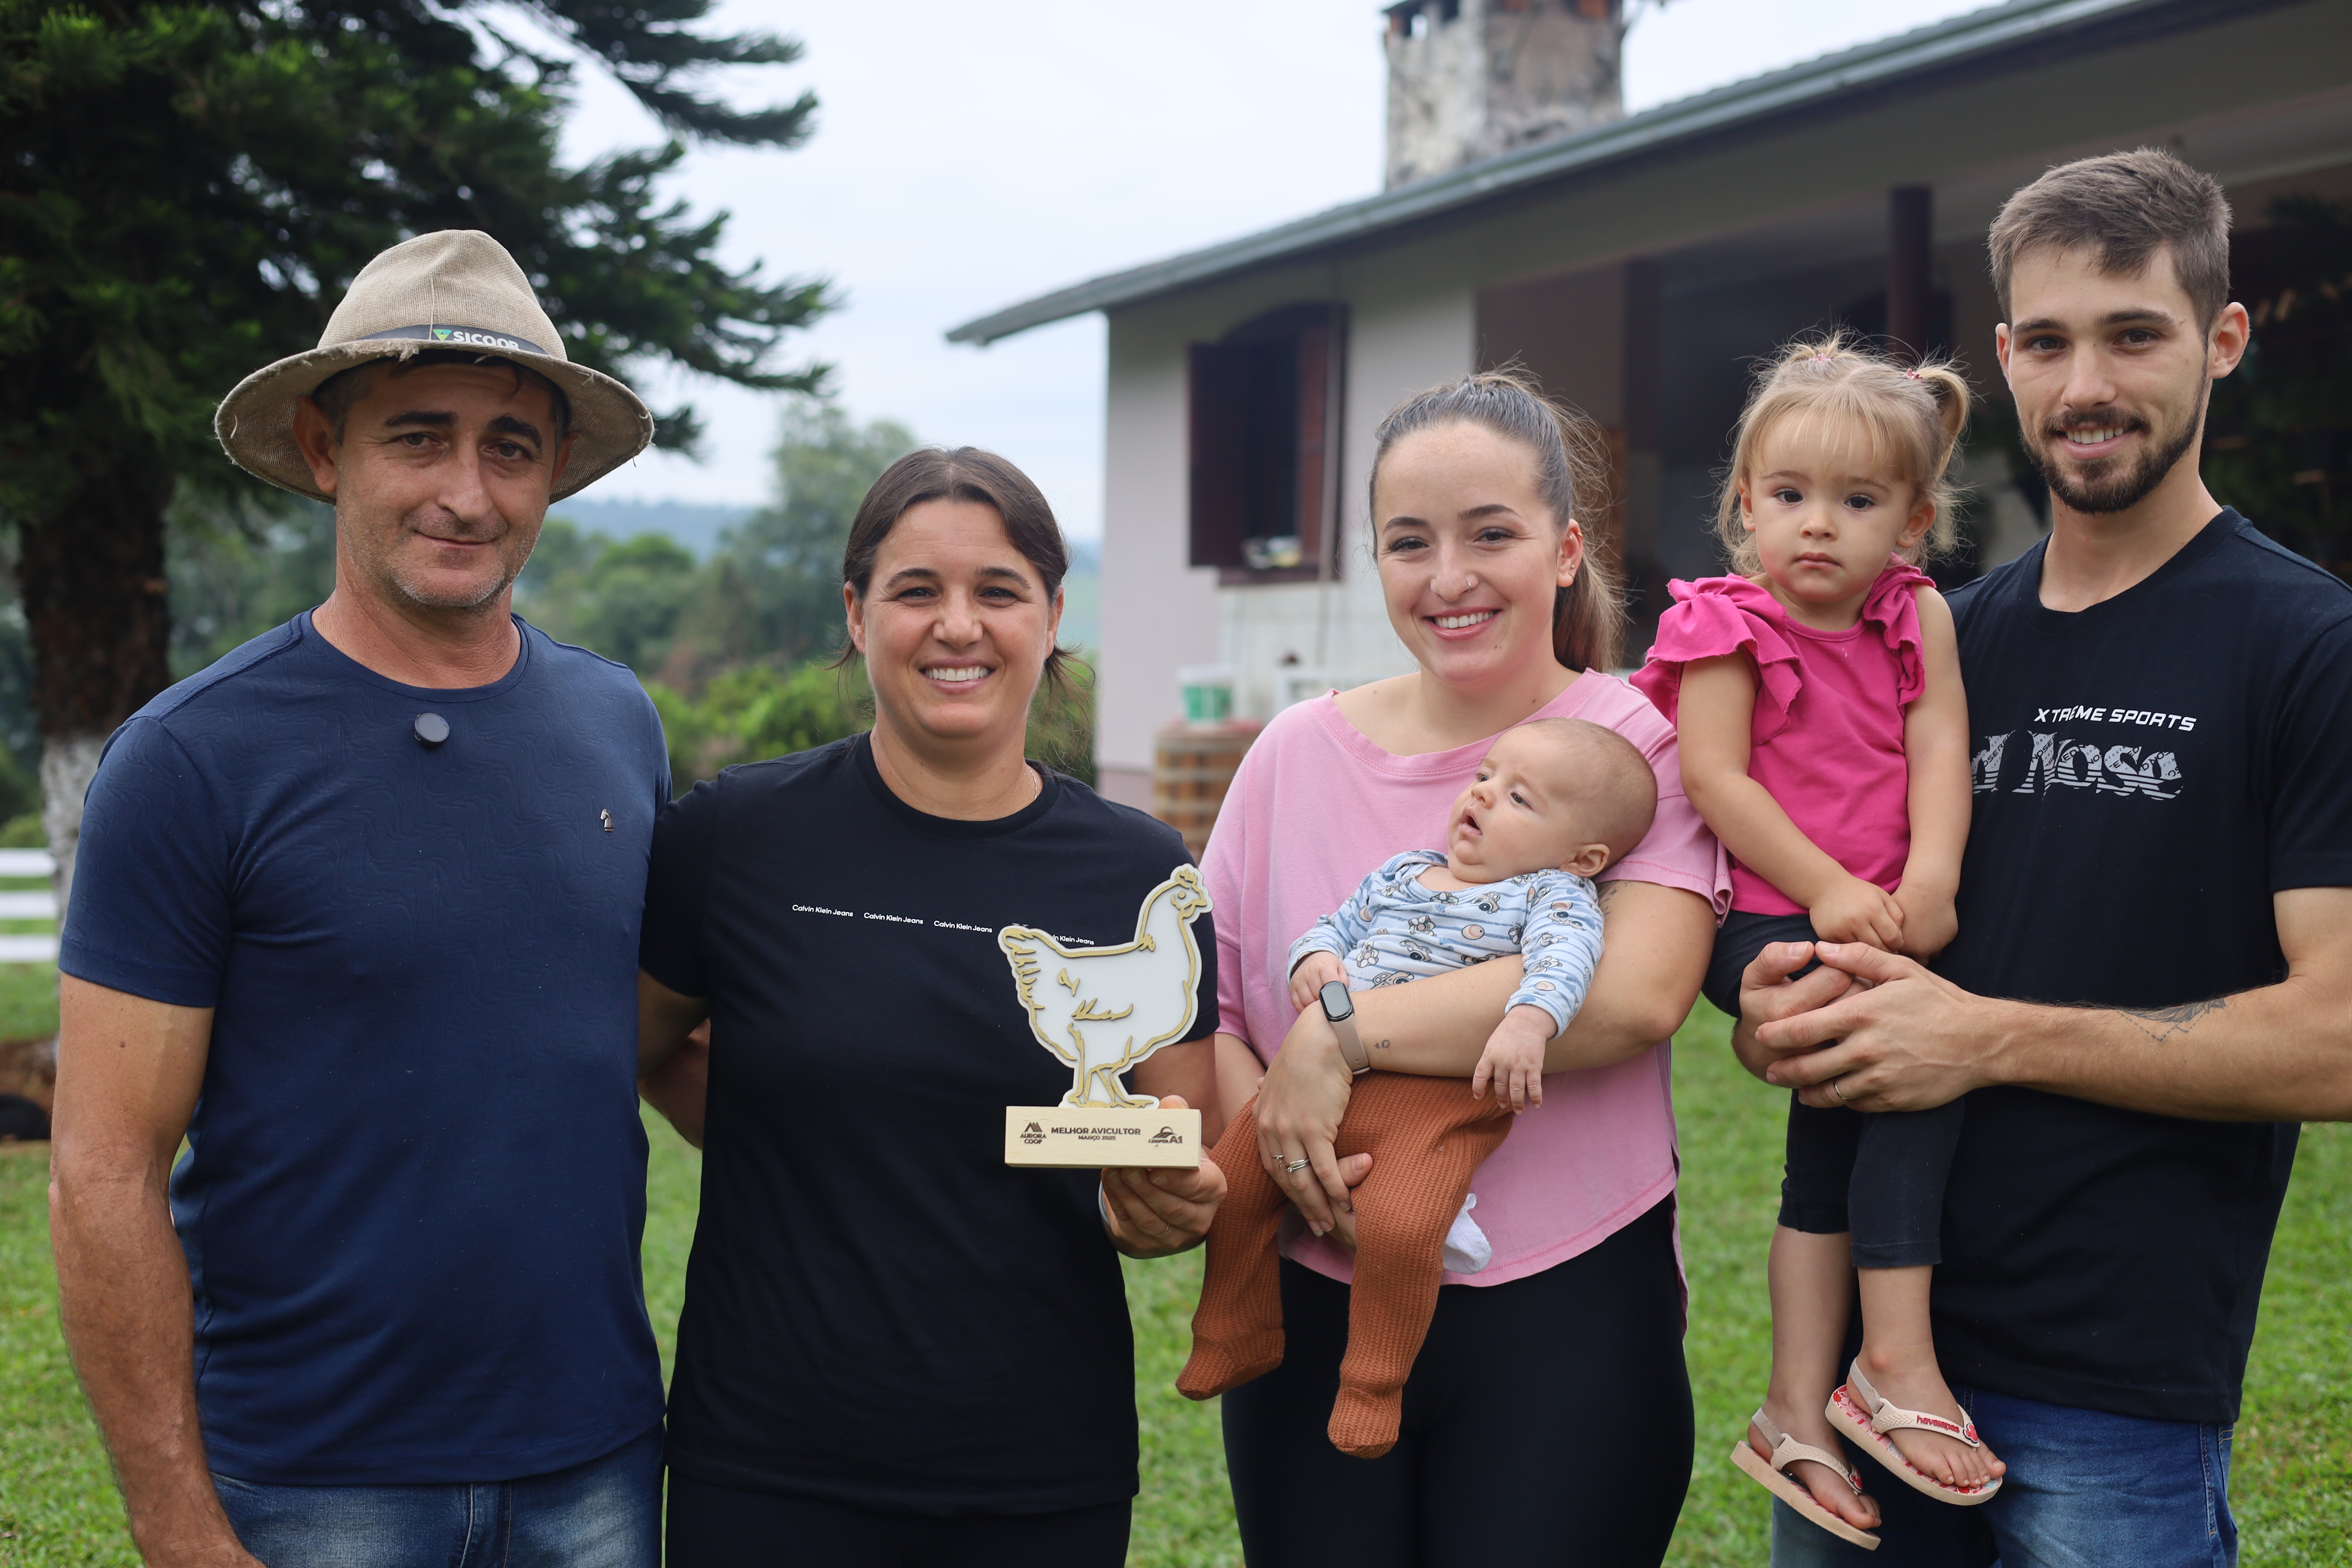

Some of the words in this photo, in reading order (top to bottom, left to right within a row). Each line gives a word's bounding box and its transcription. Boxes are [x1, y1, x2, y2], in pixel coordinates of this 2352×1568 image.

[2034, 705, 2107, 723] XTREME
[2109, 709, 2197, 731] SPORTS
[934, 920, 955, 929] Calvin
[1076, 937, 1094, 945] Jeans
